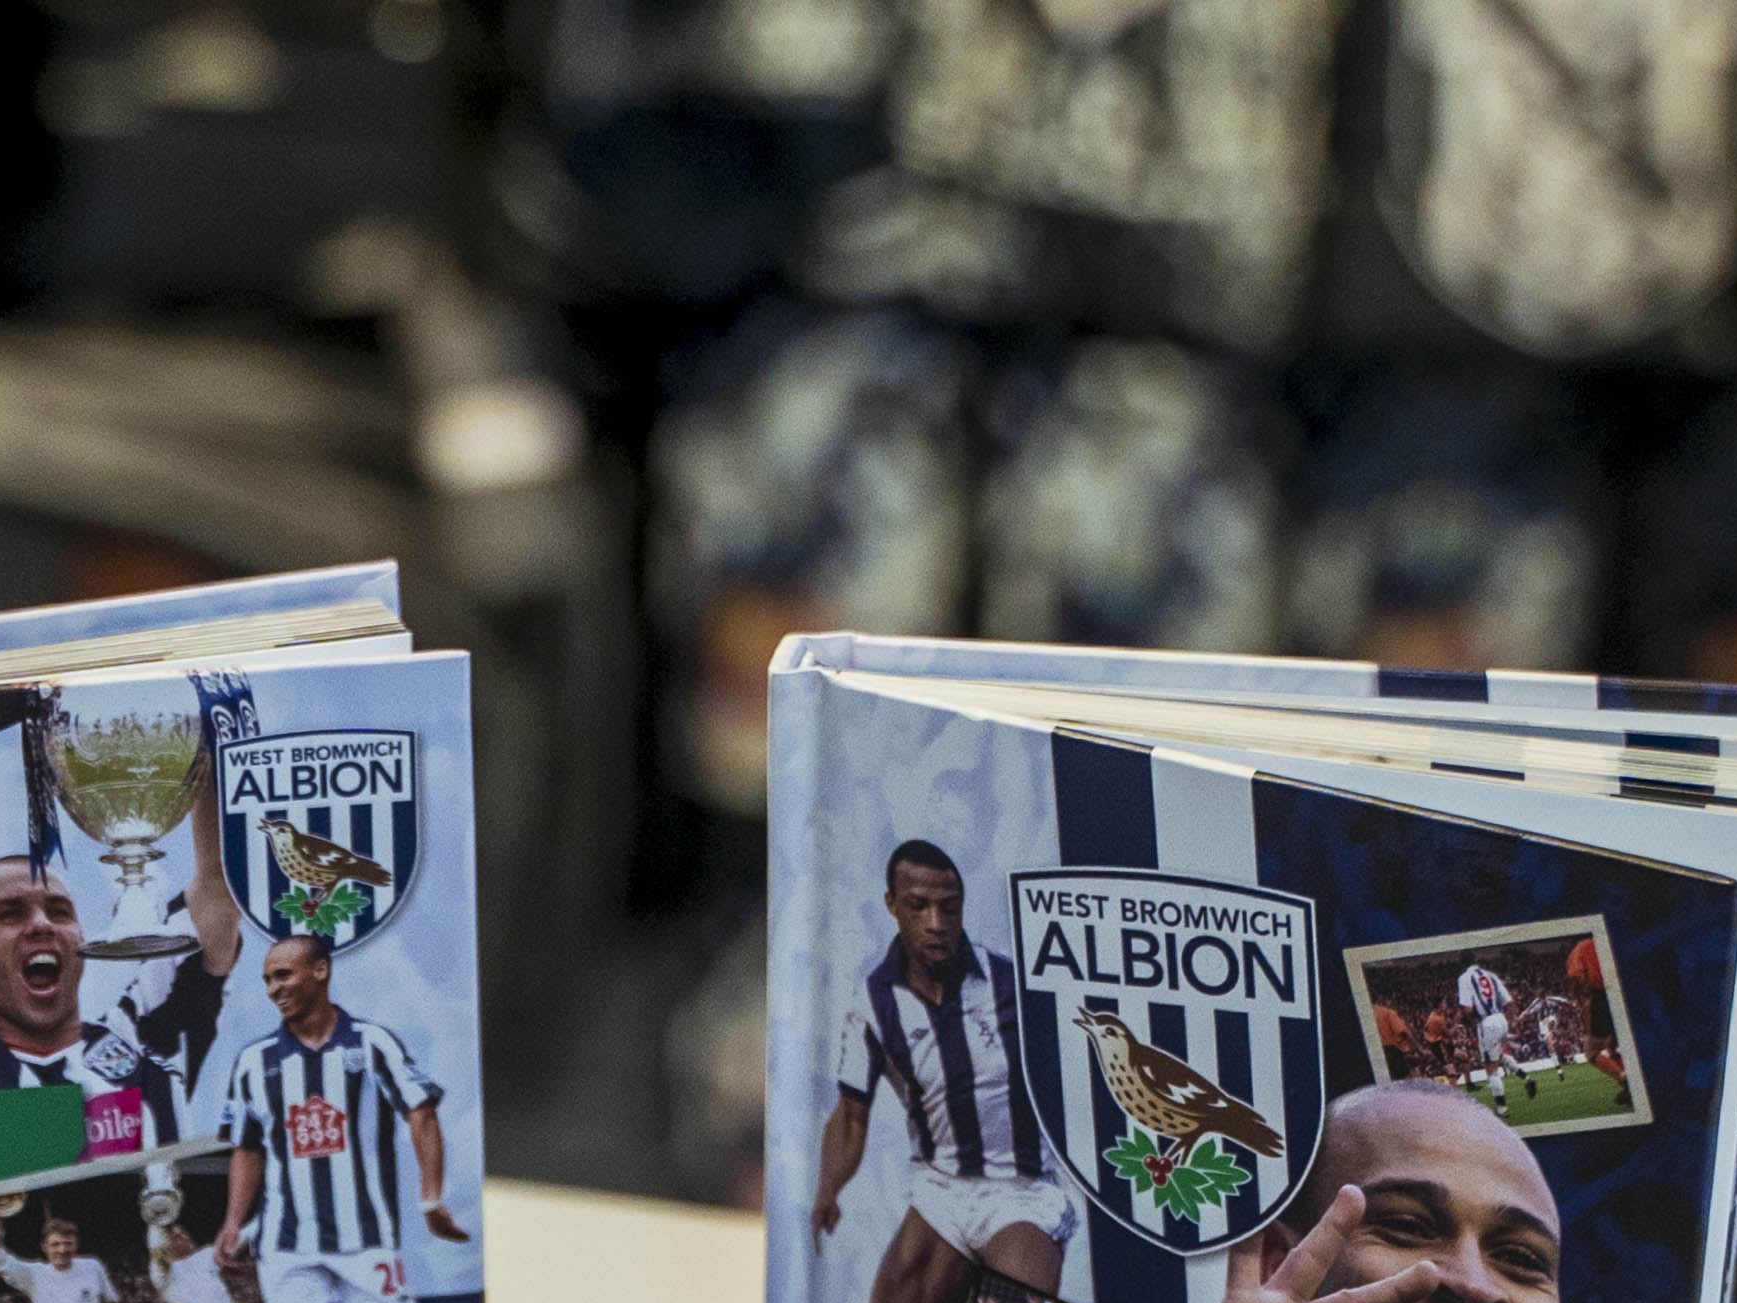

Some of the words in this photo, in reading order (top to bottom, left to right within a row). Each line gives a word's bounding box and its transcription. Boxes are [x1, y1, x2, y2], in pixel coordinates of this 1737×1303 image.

[229, 749, 283, 767] WEST
[292, 741, 402, 762] BROMWICH
[231, 759, 402, 805] ALBION
[1025, 888, 1109, 919] WEST
[1120, 898, 1292, 938] BROMWICH
[1031, 920, 1295, 1003] ALBION
